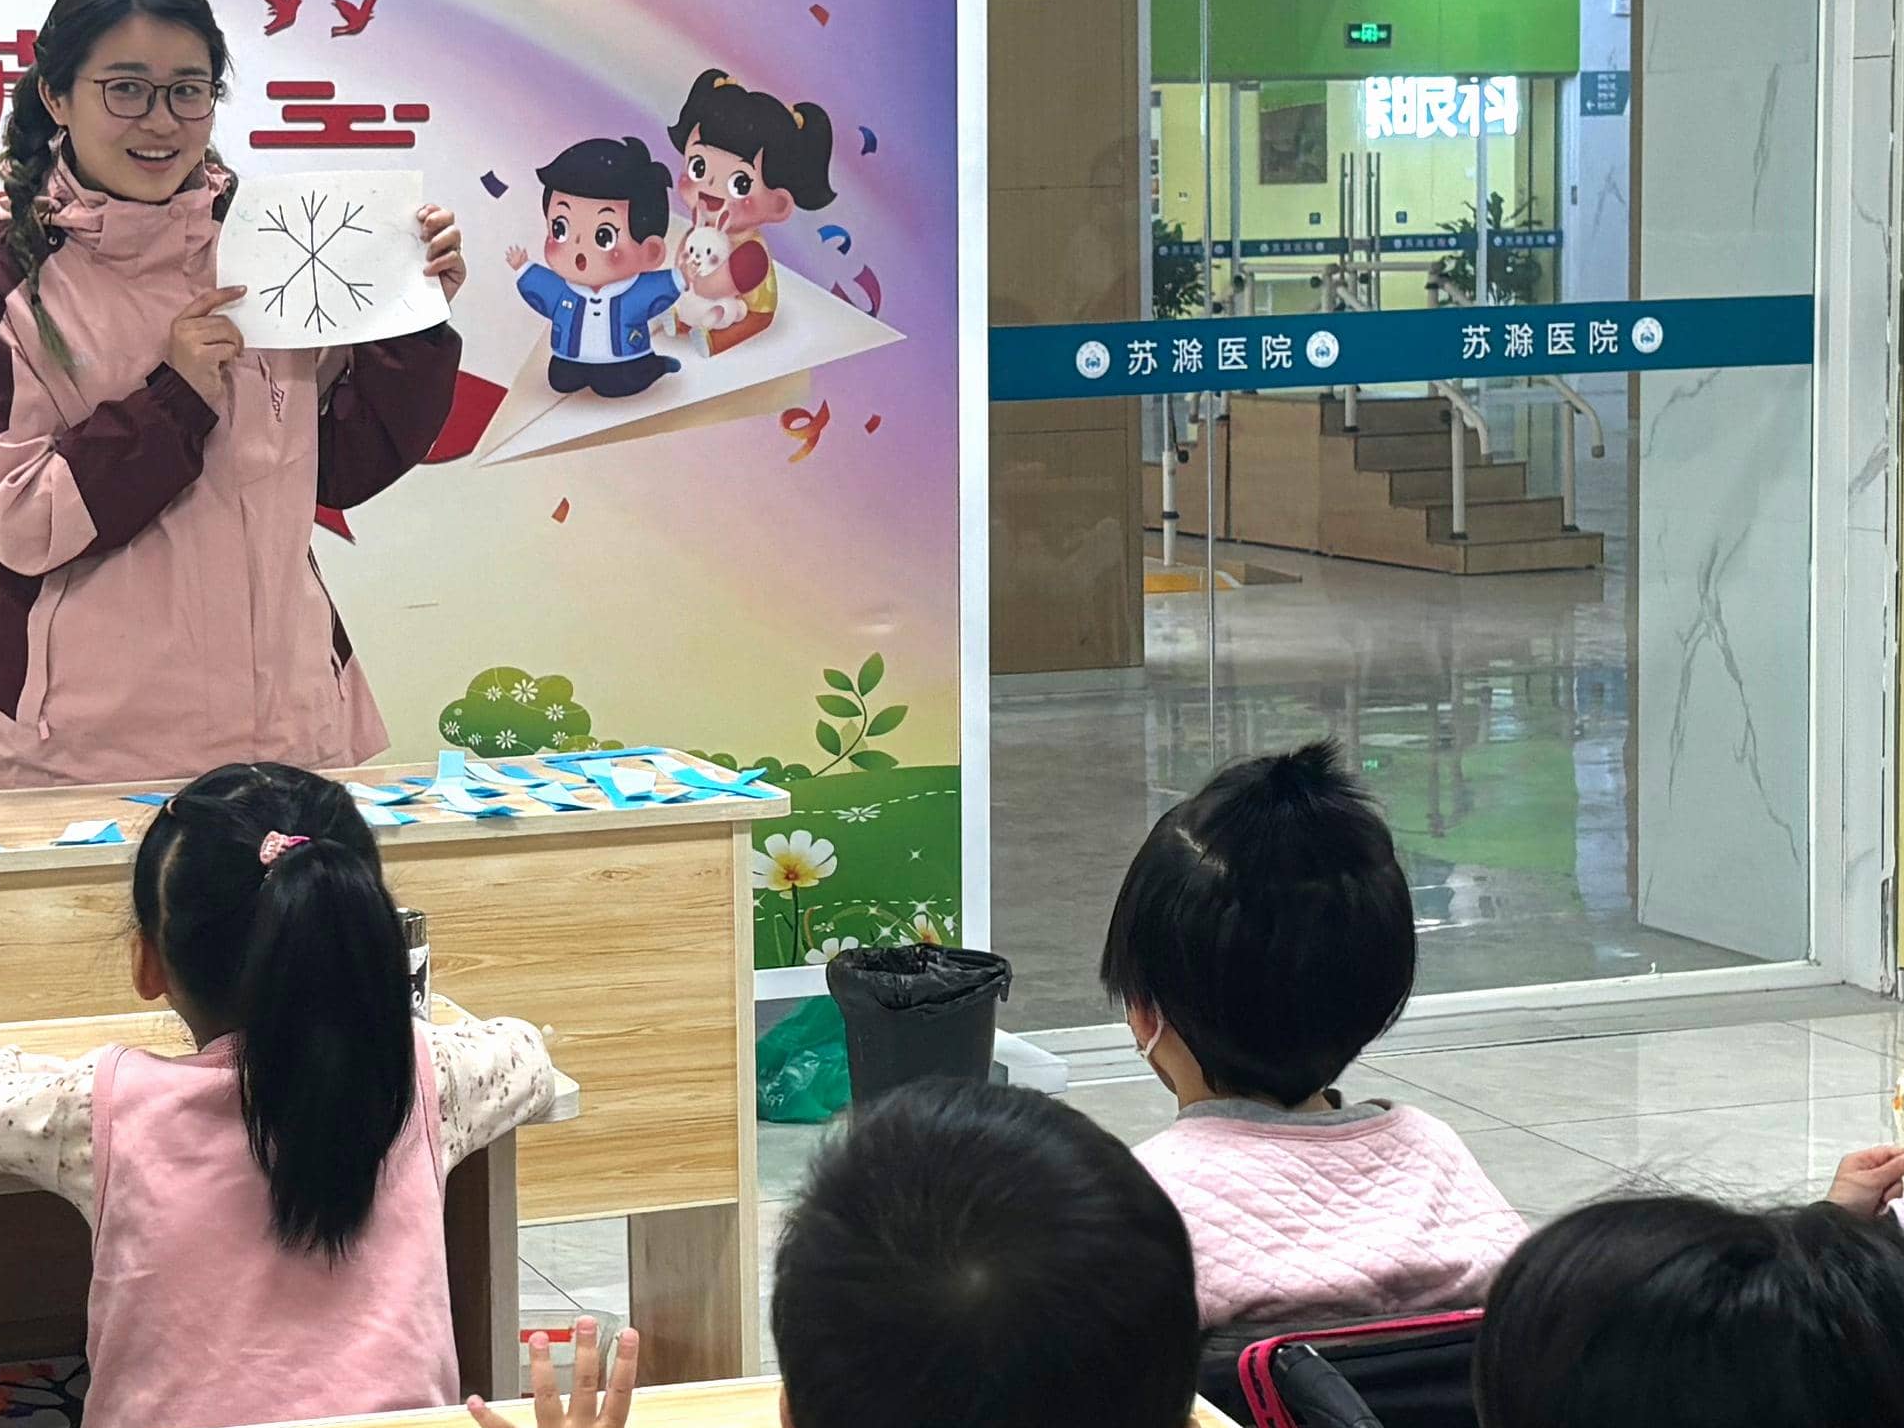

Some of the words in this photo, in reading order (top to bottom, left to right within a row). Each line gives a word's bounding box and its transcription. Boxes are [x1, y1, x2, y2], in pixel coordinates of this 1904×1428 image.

[1127, 334, 1292, 376] 苏滁医院
[1461, 319, 1620, 360] 苏滁医院
